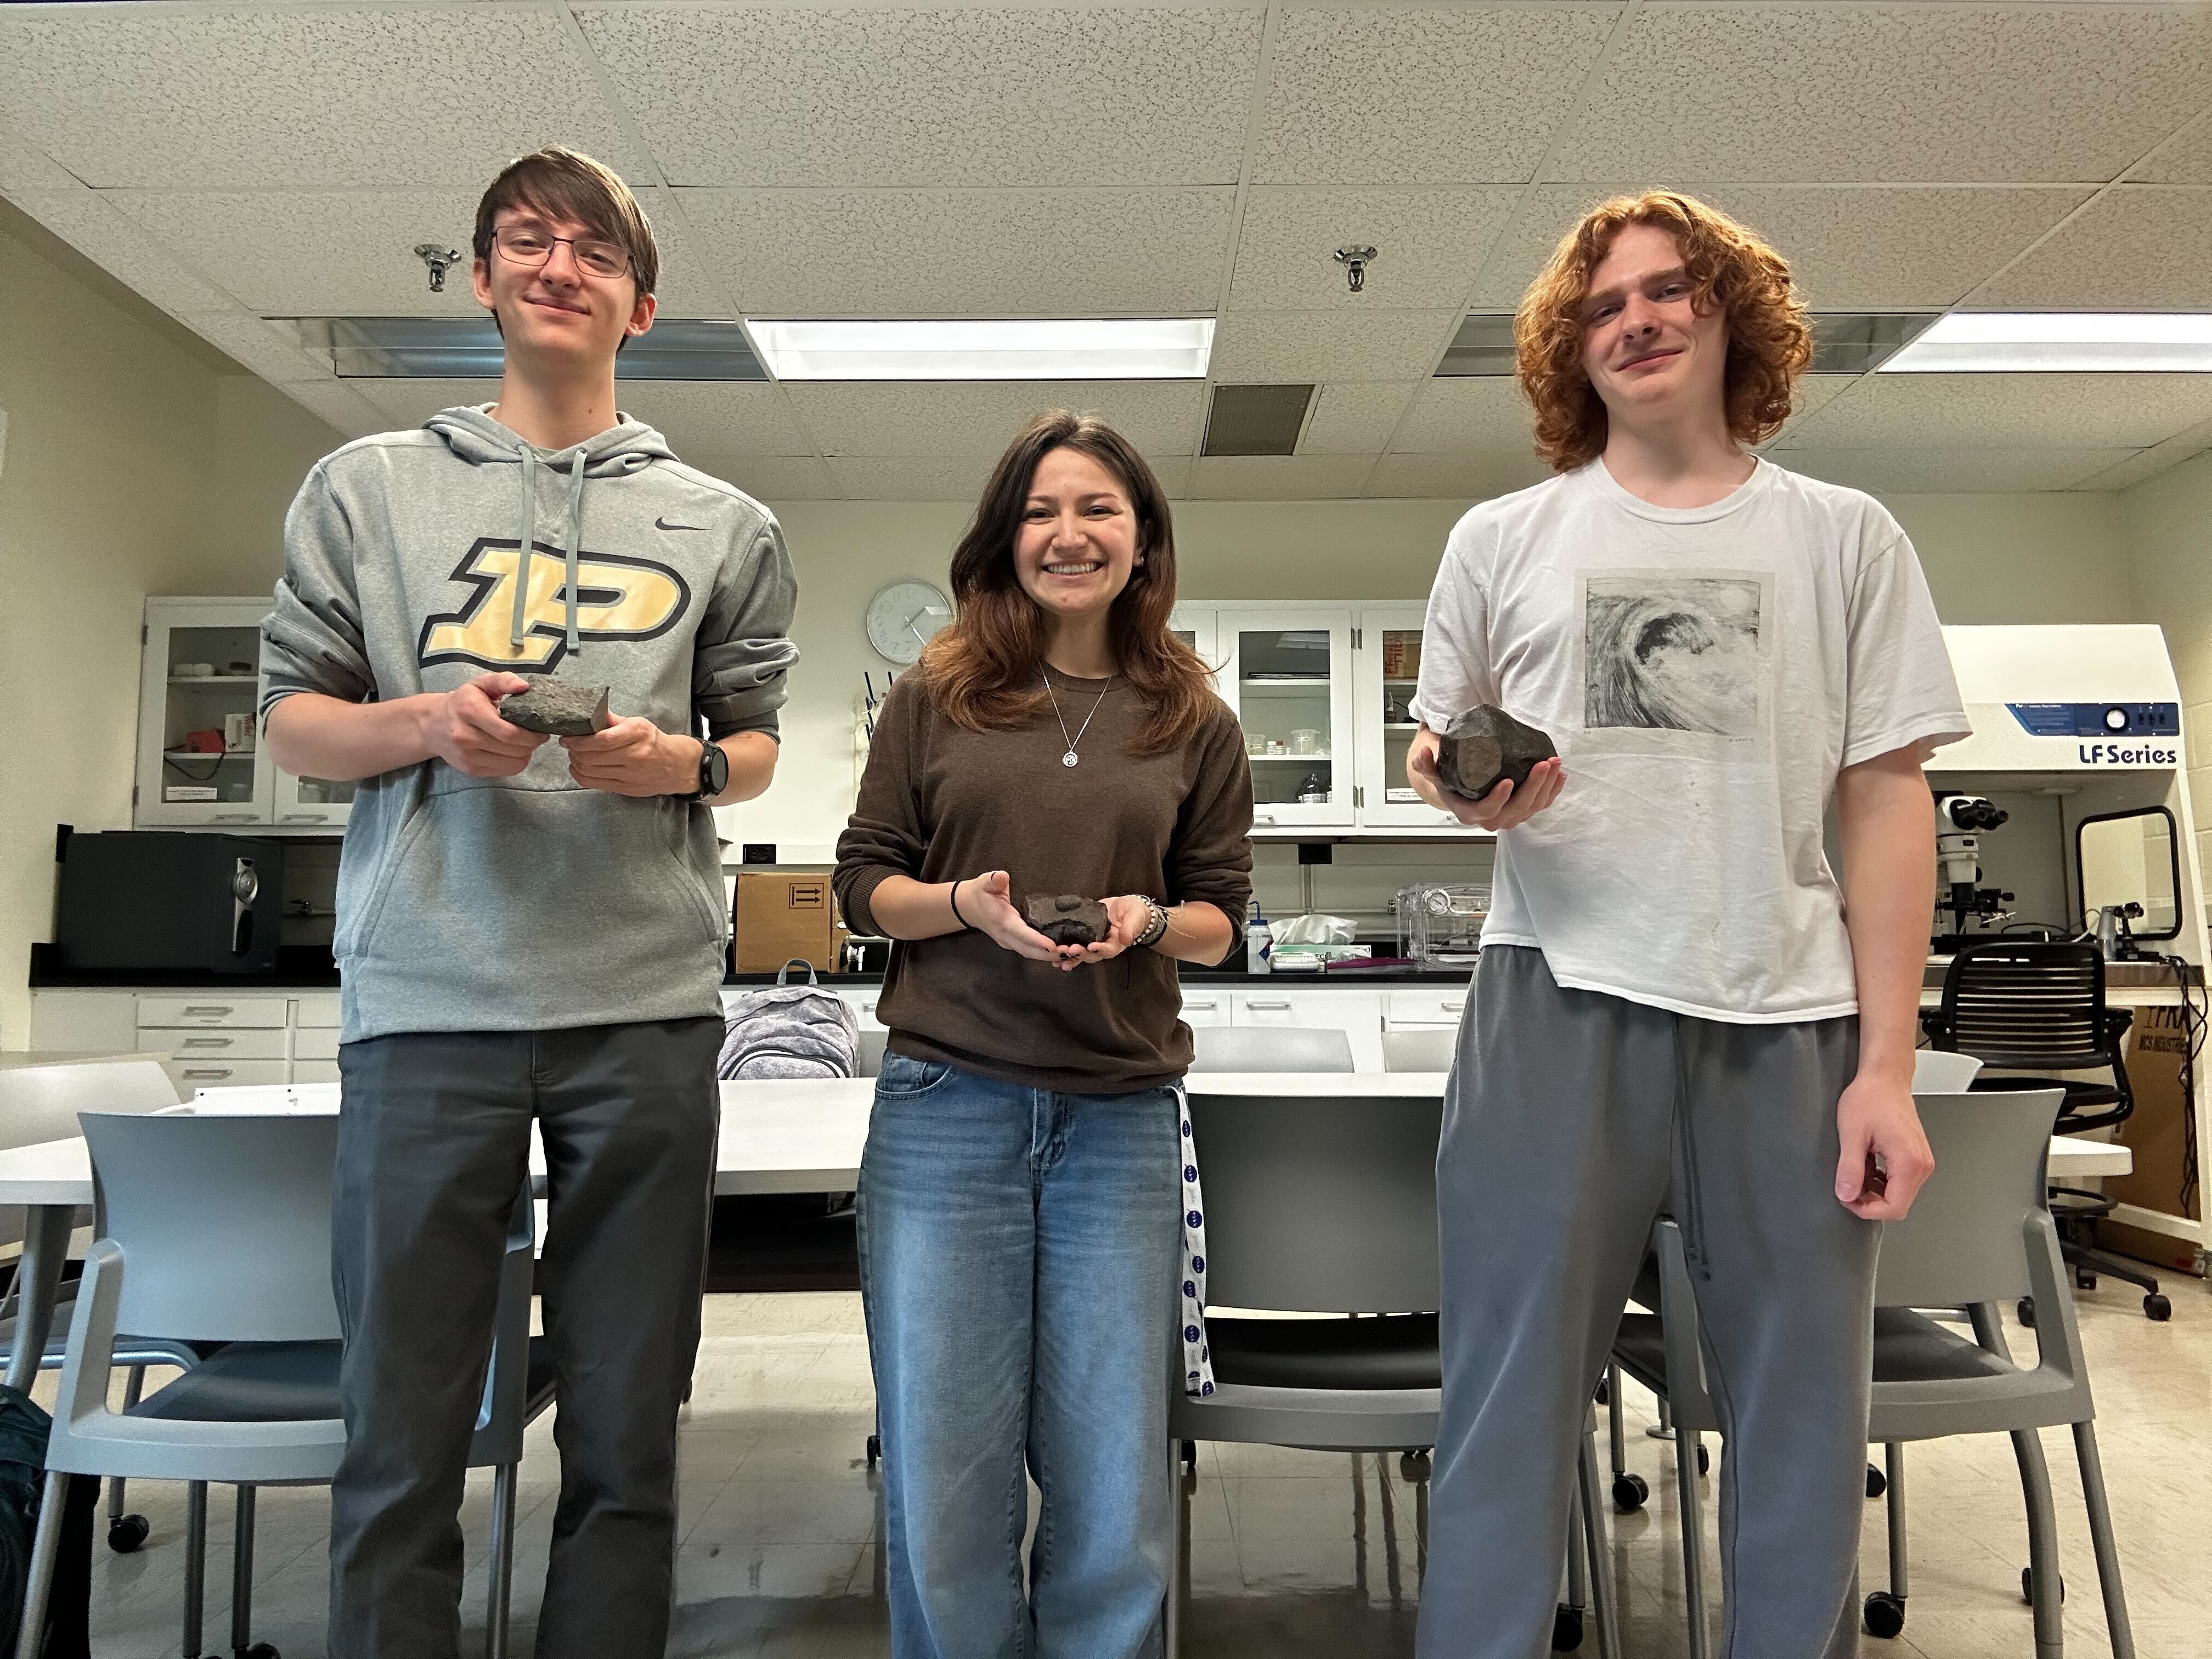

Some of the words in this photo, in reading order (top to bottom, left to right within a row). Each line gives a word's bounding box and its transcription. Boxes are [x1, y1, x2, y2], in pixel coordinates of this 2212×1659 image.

[417, 537, 691, 674] P
[2079, 744, 2103, 764] LF
[2107, 744, 2177, 764] Series
